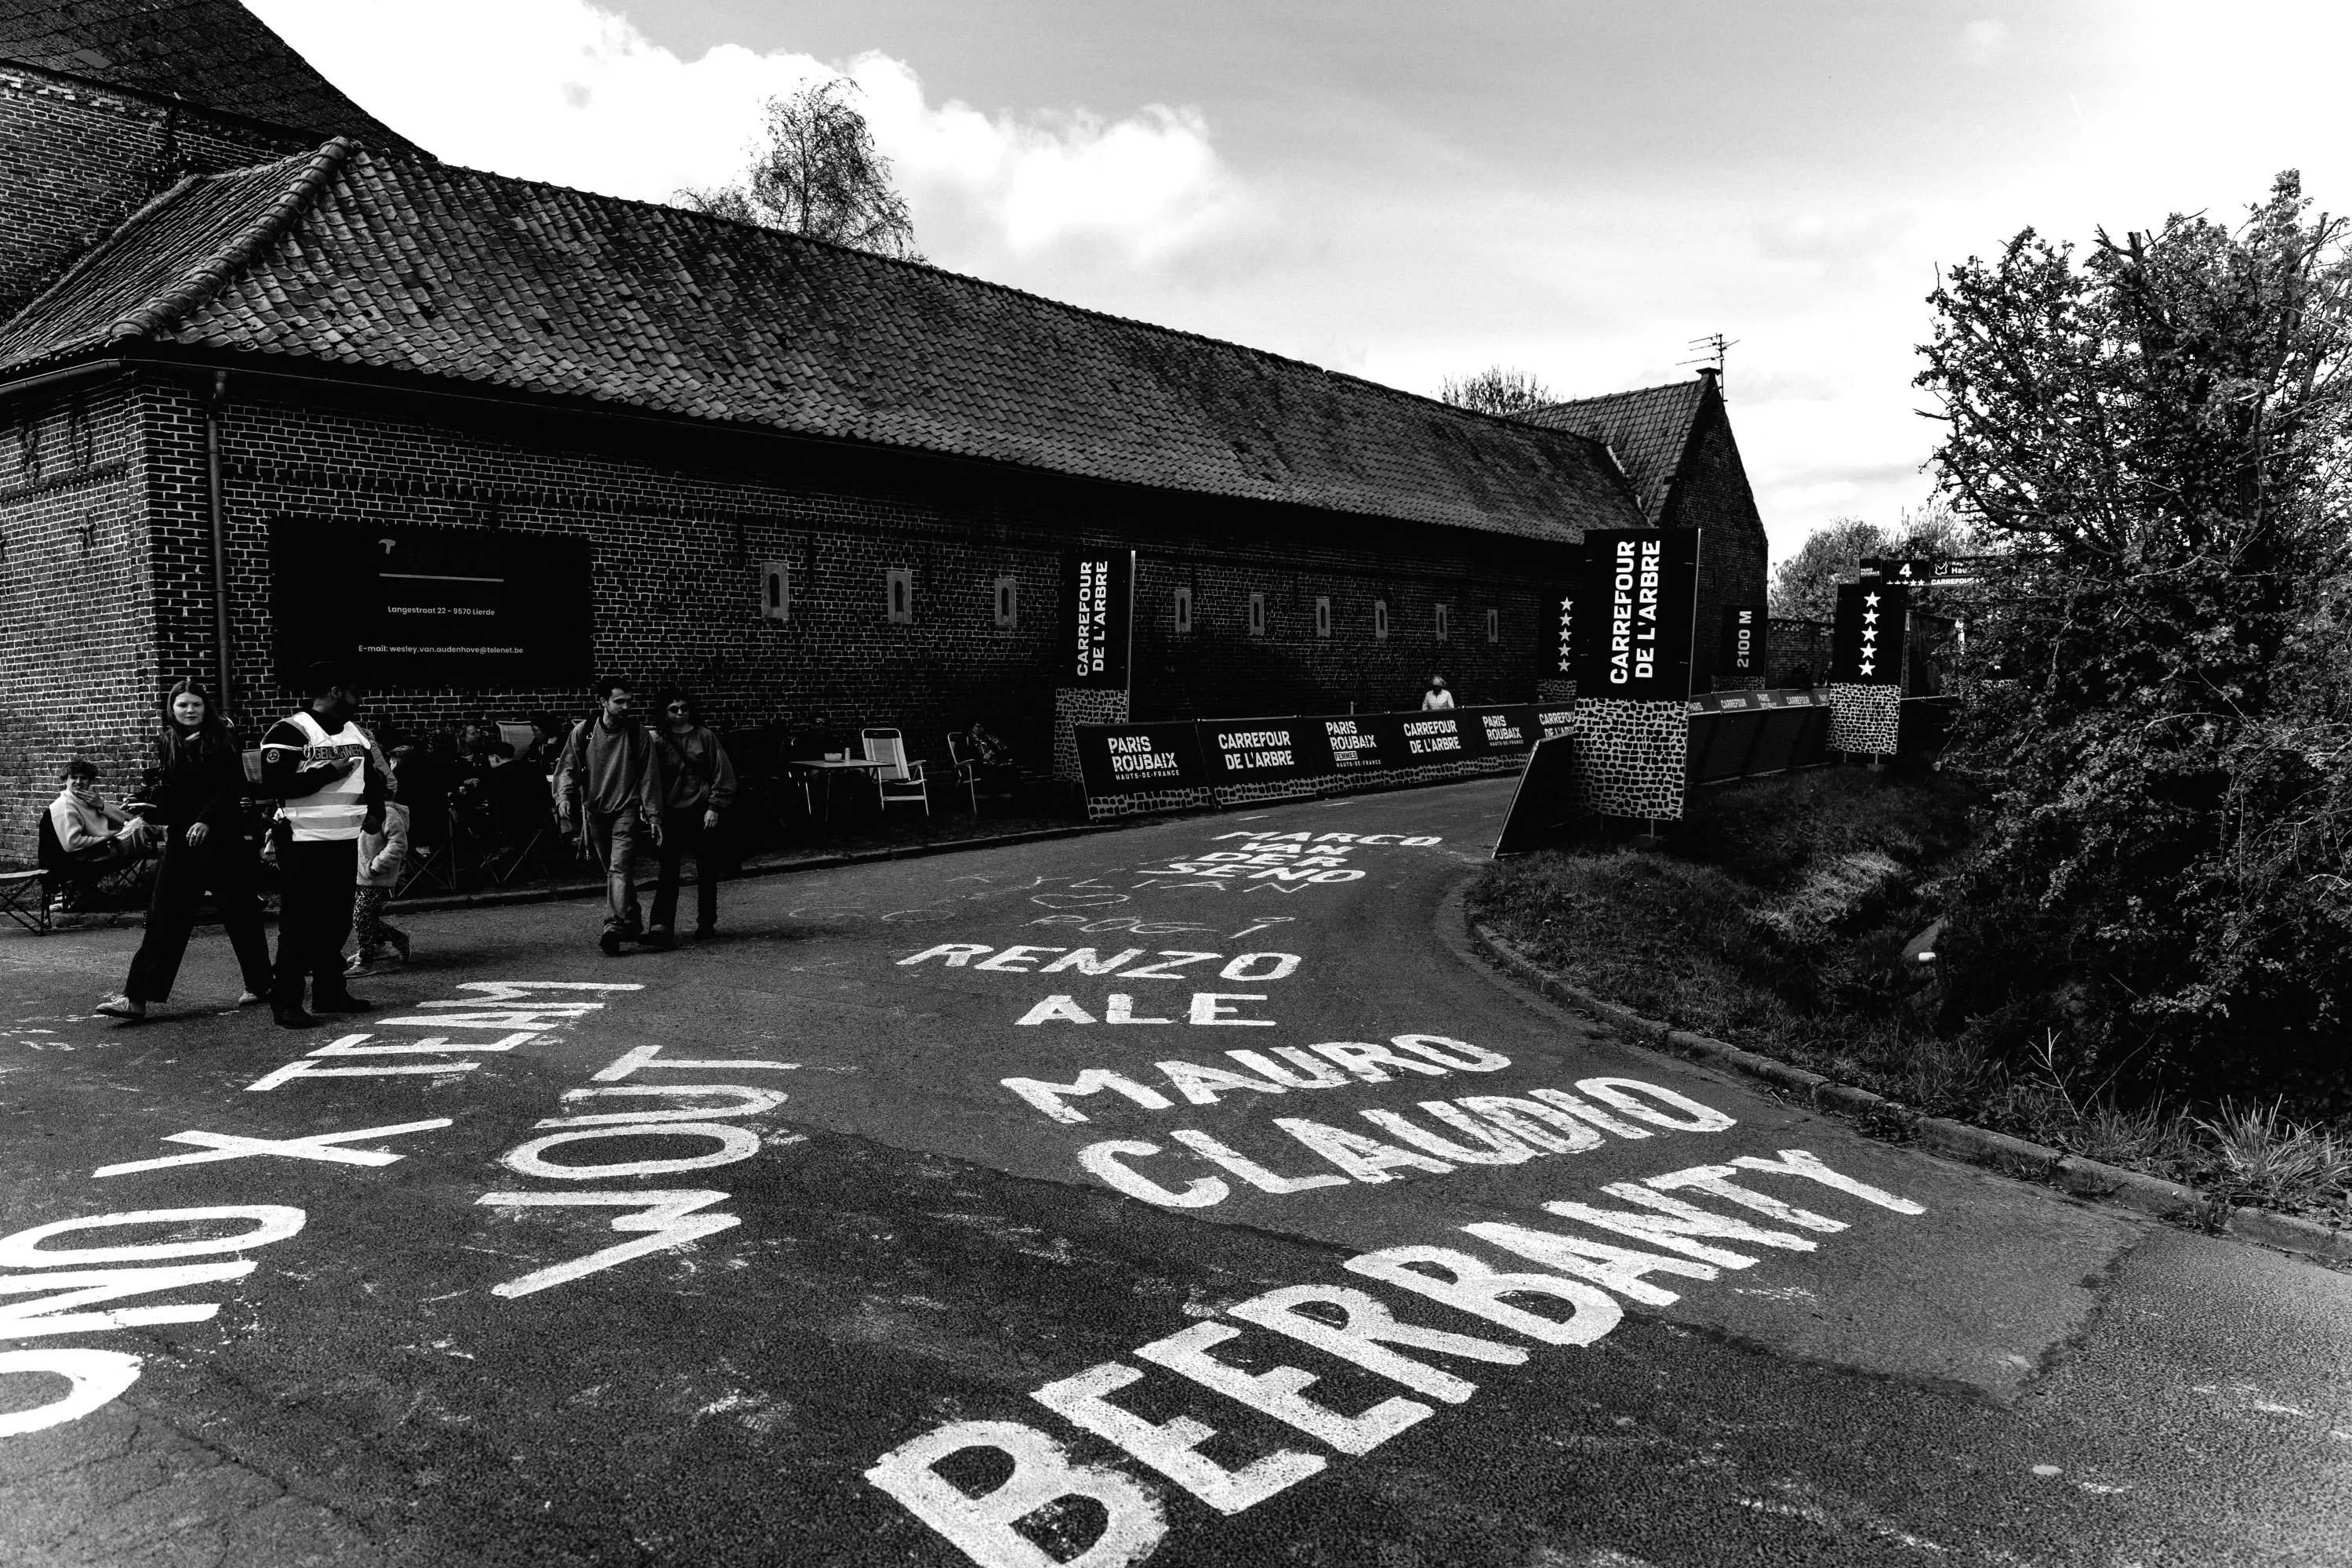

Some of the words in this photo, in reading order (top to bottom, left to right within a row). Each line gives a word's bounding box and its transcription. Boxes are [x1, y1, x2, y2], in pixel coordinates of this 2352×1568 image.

[1898, 563, 1911, 578] 4
[1637, 540, 1661, 641] L'ARBRE
[1094, 561, 1109, 641] L'ARBRE
[388, 606, 436, 615] Langestraat
[1076, 561, 1093, 677] CARREFOUR
[1610, 540, 1635, 684] CARREFOUR
[1739, 611, 1752, 624] M
[390, 646, 524, 655] wesley.van.audenhove@telenet.be
[1737, 629, 1751, 668] 2100
[1092, 647, 1105, 672] DE
[1635, 648, 1654, 678] DE
[1721, 698, 1748, 709] CARREFOUR
[1787, 696, 1810, 705] CARREFOUR
[1483, 715, 1507, 728] PARIS
[1538, 711, 1575, 725] CARREFOU
[1326, 720, 1358, 735] PARIS
[1403, 720, 1458, 737] CARREFOUR
[1486, 728, 1523, 741] ROUBAIX
[1107, 735, 1152, 753] PARIS
[1218, 731, 1292, 750] CARREFOUR
[1330, 735, 1377, 750] ROUBAIX
[1409, 740, 1425, 754] DE
[1425, 736, 1461, 752] L'ARBRE
[314, 745, 365, 760] GENDARMERI
[1225, 753, 1244, 770] DE
[1246, 750, 1294, 769] L'ARBRE
[1334, 751, 1358, 760] FEMMES
[1112, 753, 1178, 772] ROUBAIX
[1210, 832, 1443, 846] MARCO
[1240, 843, 1358, 855] VAN
[1195, 852, 1348, 867] DER
[1136, 862, 1367, 883] SENO
[895, 943, 1301, 981] RENZO
[1015, 993, 1276, 1026] ALE
[242, 980, 644, 1092] TEAM
[1000, 1034, 1512, 1124] MAURO
[93, 1117, 453, 1178] X
[1077, 1076, 1738, 1210] CLAUDIO
[474, 1044, 803, 1299] WOUT
[864, 1149, 1926, 1568] BEERBANTY
